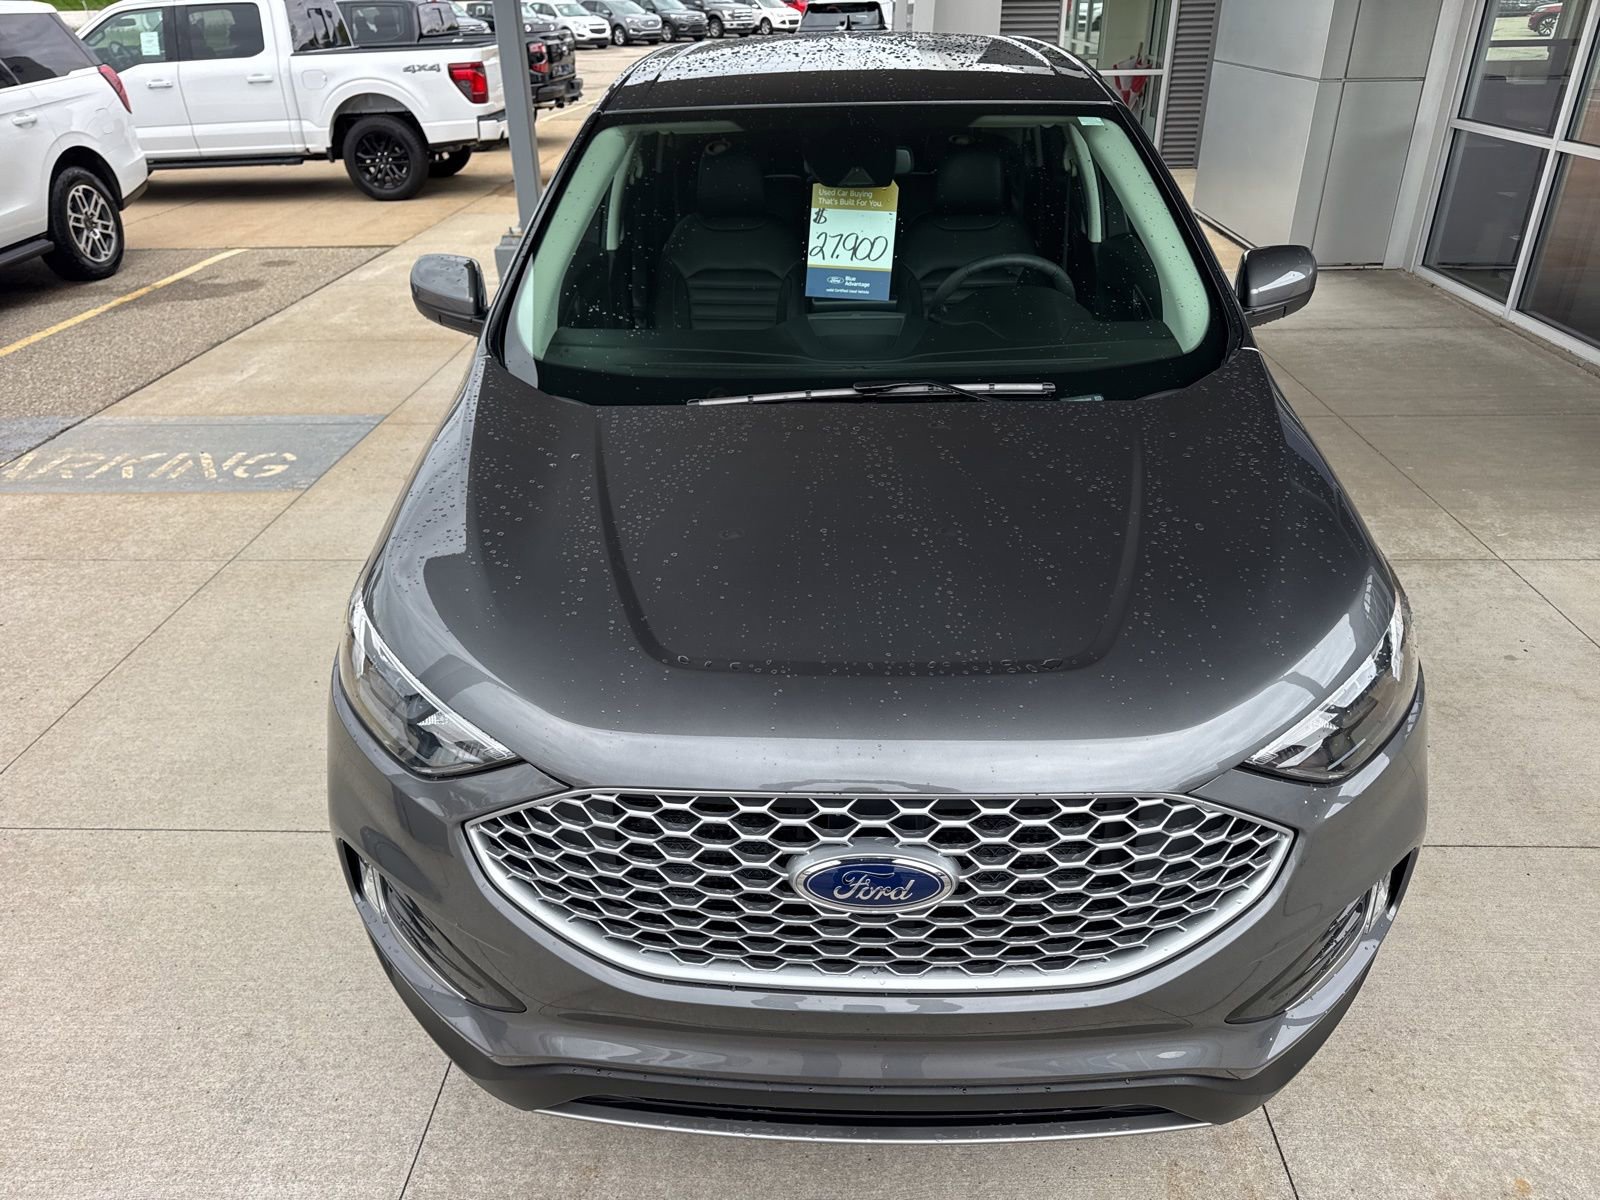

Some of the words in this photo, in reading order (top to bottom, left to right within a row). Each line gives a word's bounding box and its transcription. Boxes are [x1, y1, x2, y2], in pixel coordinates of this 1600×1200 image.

[849, 190, 873, 199] Buying
[818, 197, 838, 205] That's
[839, 198, 855, 206] Built
[833, 870, 916, 901] Ford
